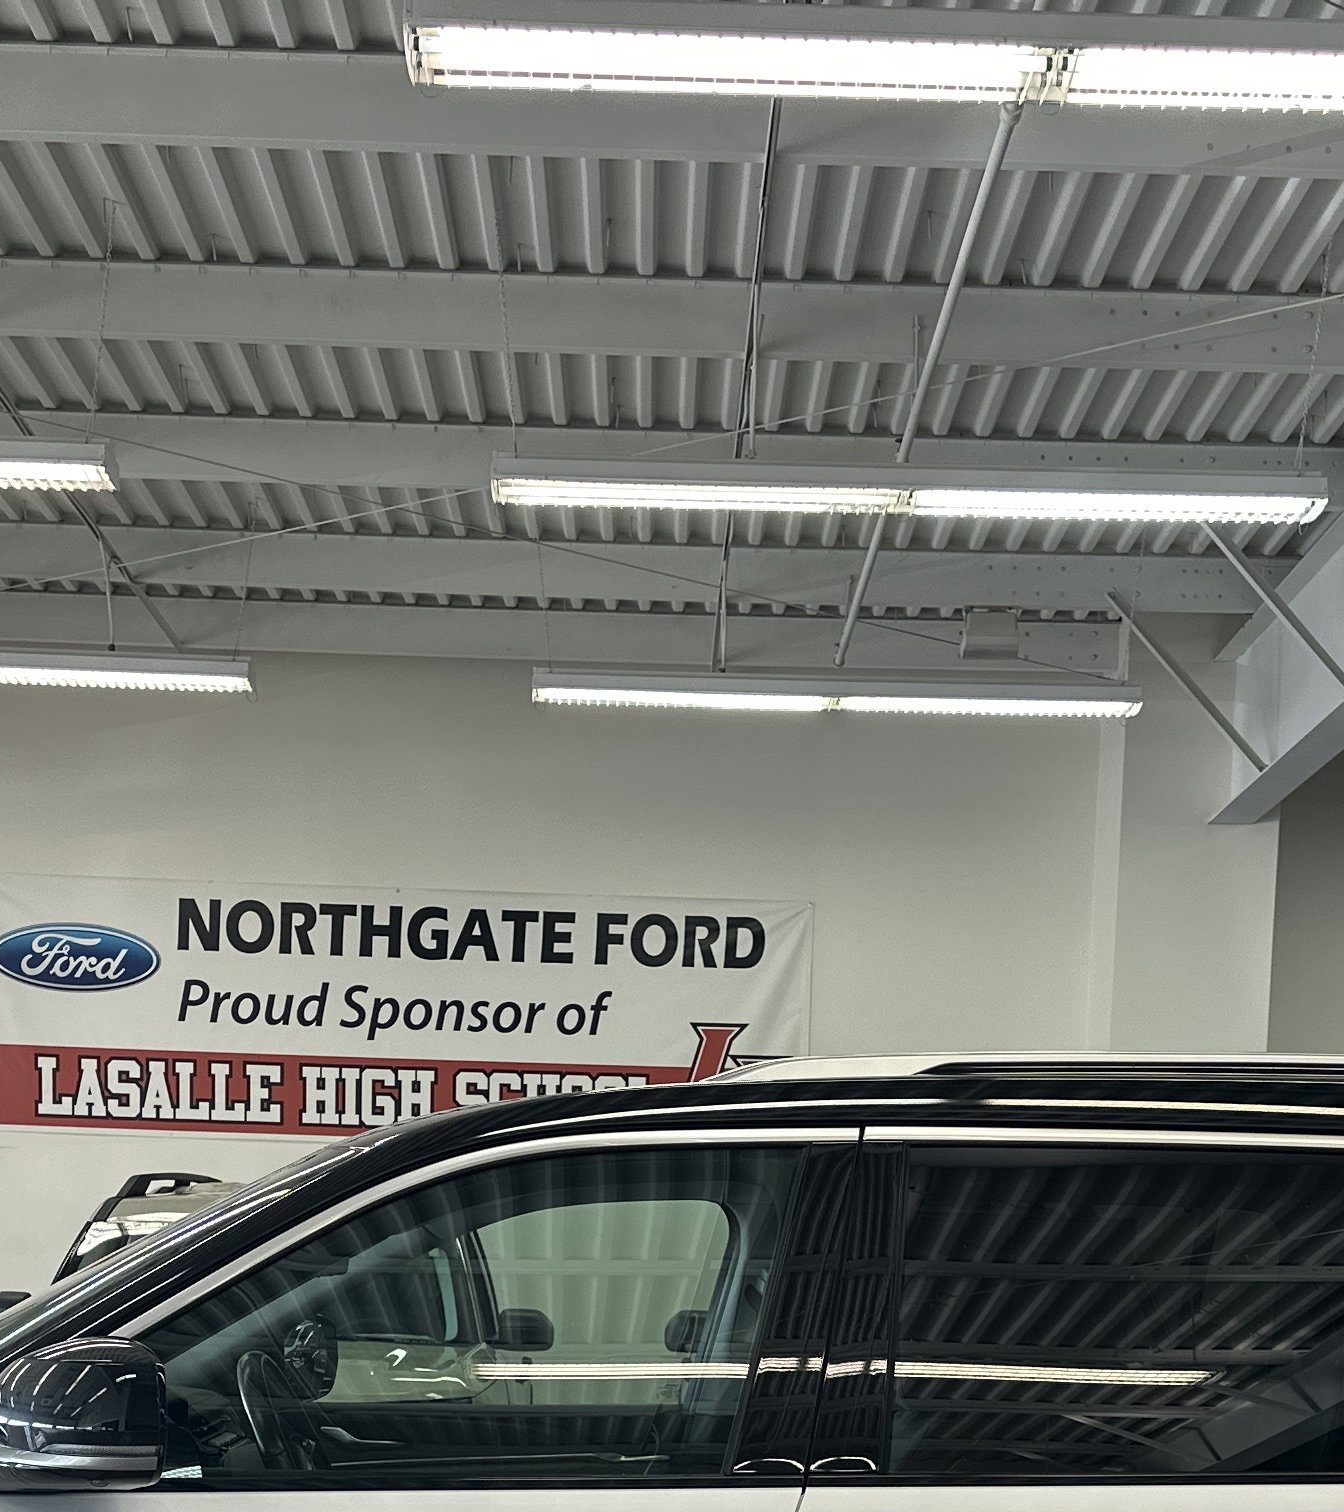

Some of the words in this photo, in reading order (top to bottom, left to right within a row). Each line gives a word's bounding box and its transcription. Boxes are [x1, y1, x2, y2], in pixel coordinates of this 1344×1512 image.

[21, 933, 129, 981] Ford
[177, 897, 576, 965] NORTHGATE
[594, 912, 766, 969] FORD
[177, 979, 330, 1028] Proud
[339, 984, 547, 1041] Sponsor
[556, 990, 613, 1036] of
[35, 1053, 286, 1126] LASALLE
[299, 1064, 435, 1129] HIGH
